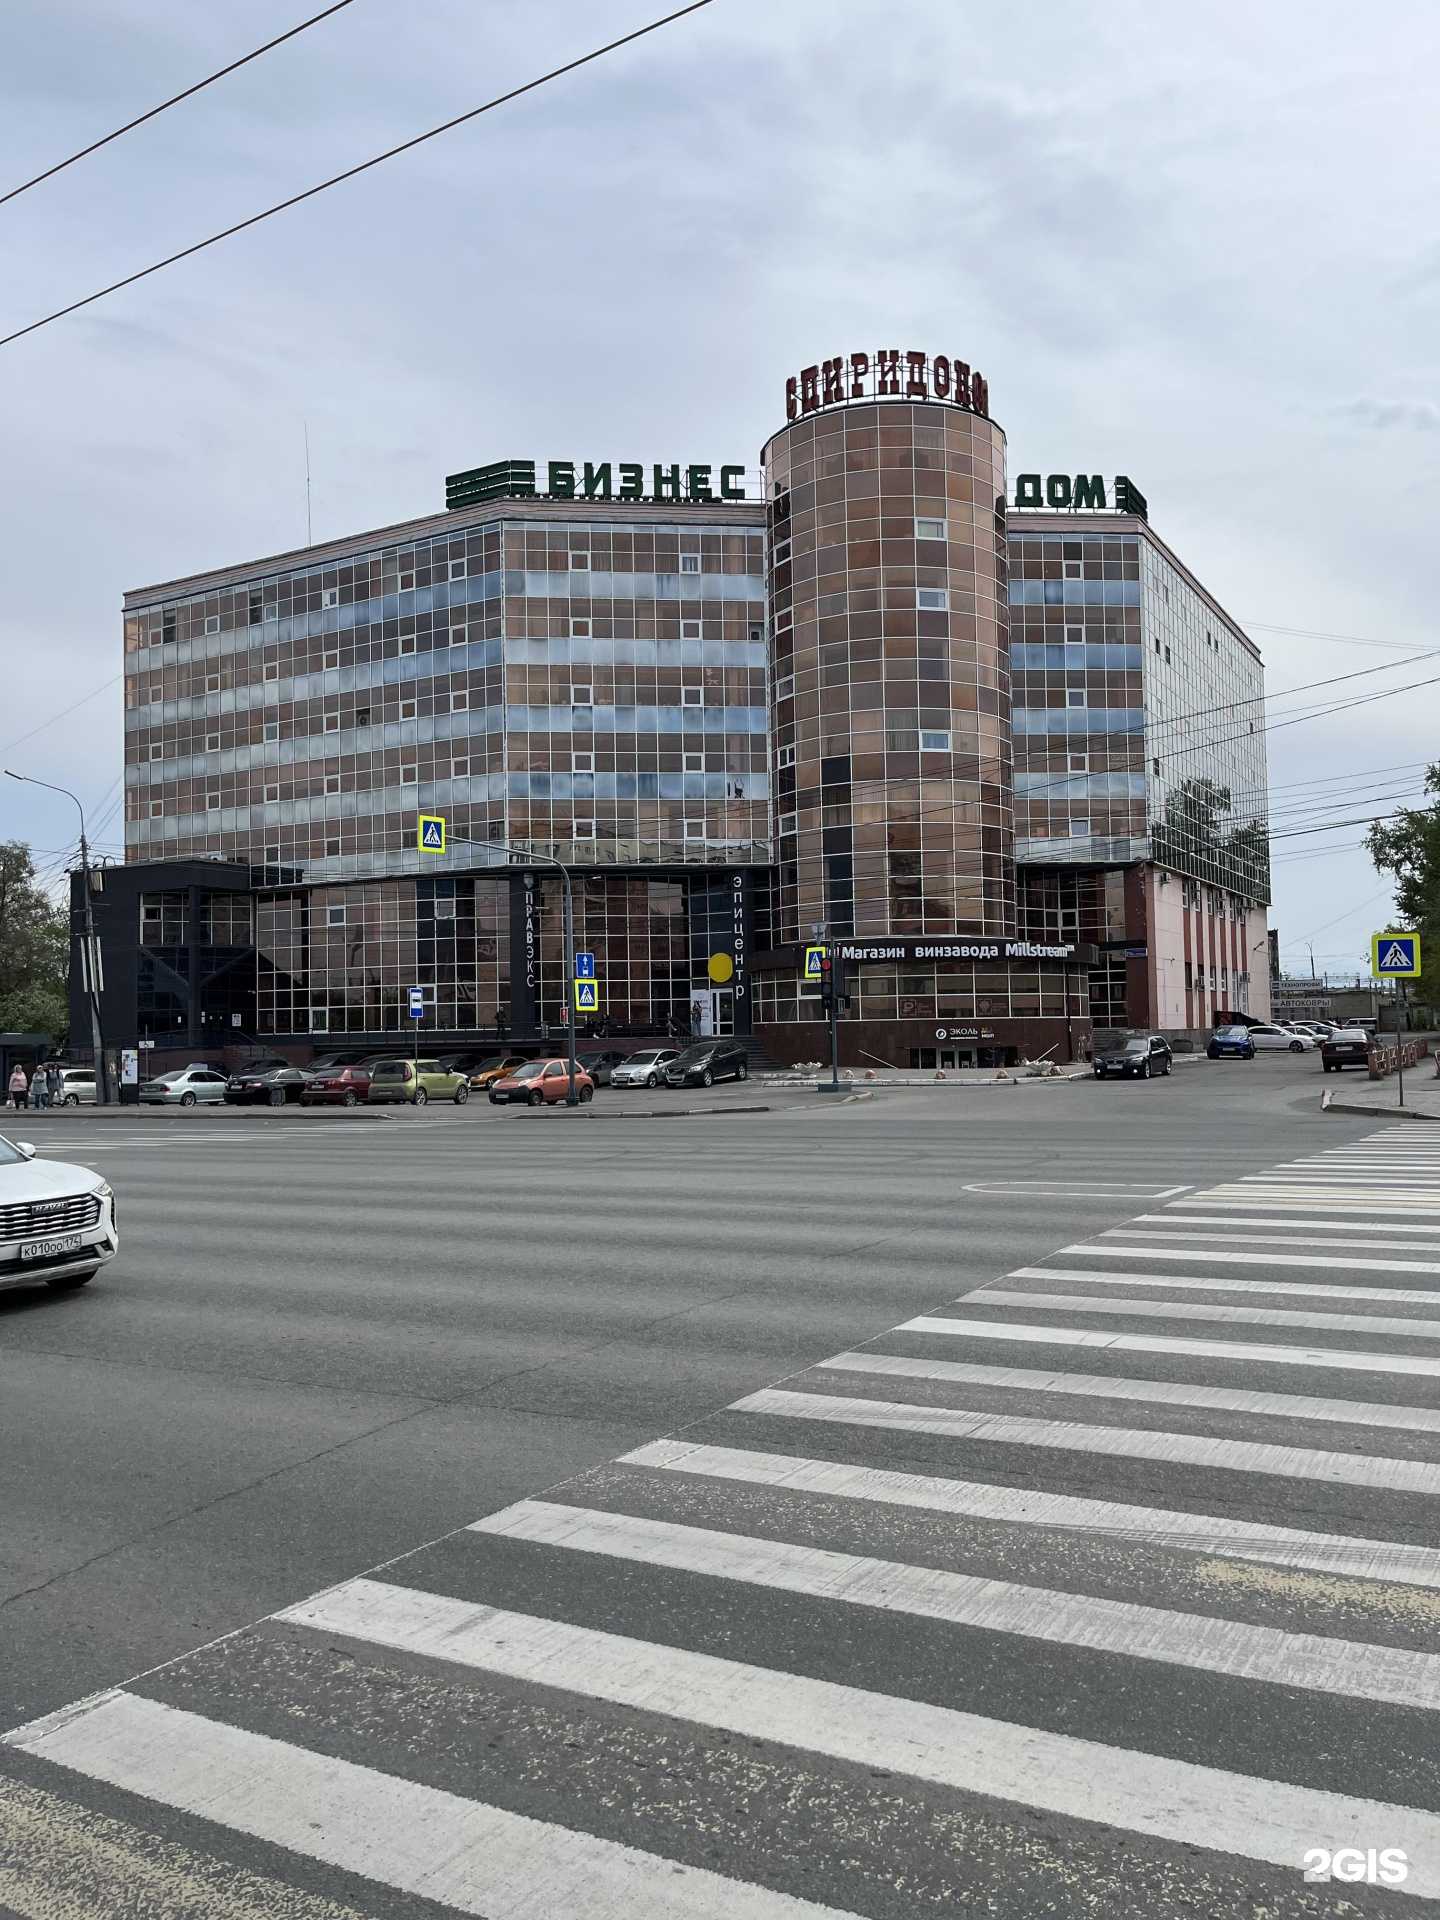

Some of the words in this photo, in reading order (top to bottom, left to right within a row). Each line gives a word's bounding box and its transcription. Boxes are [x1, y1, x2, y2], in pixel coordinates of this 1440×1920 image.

[548, 461, 745, 499] БИЗНЕС
[1015, 474, 1106, 508] ДОМ
[525, 891, 534, 987] ПРАВЭКС
[841, 946, 905, 959] Магазин
[915, 946, 998, 959] винзавода
